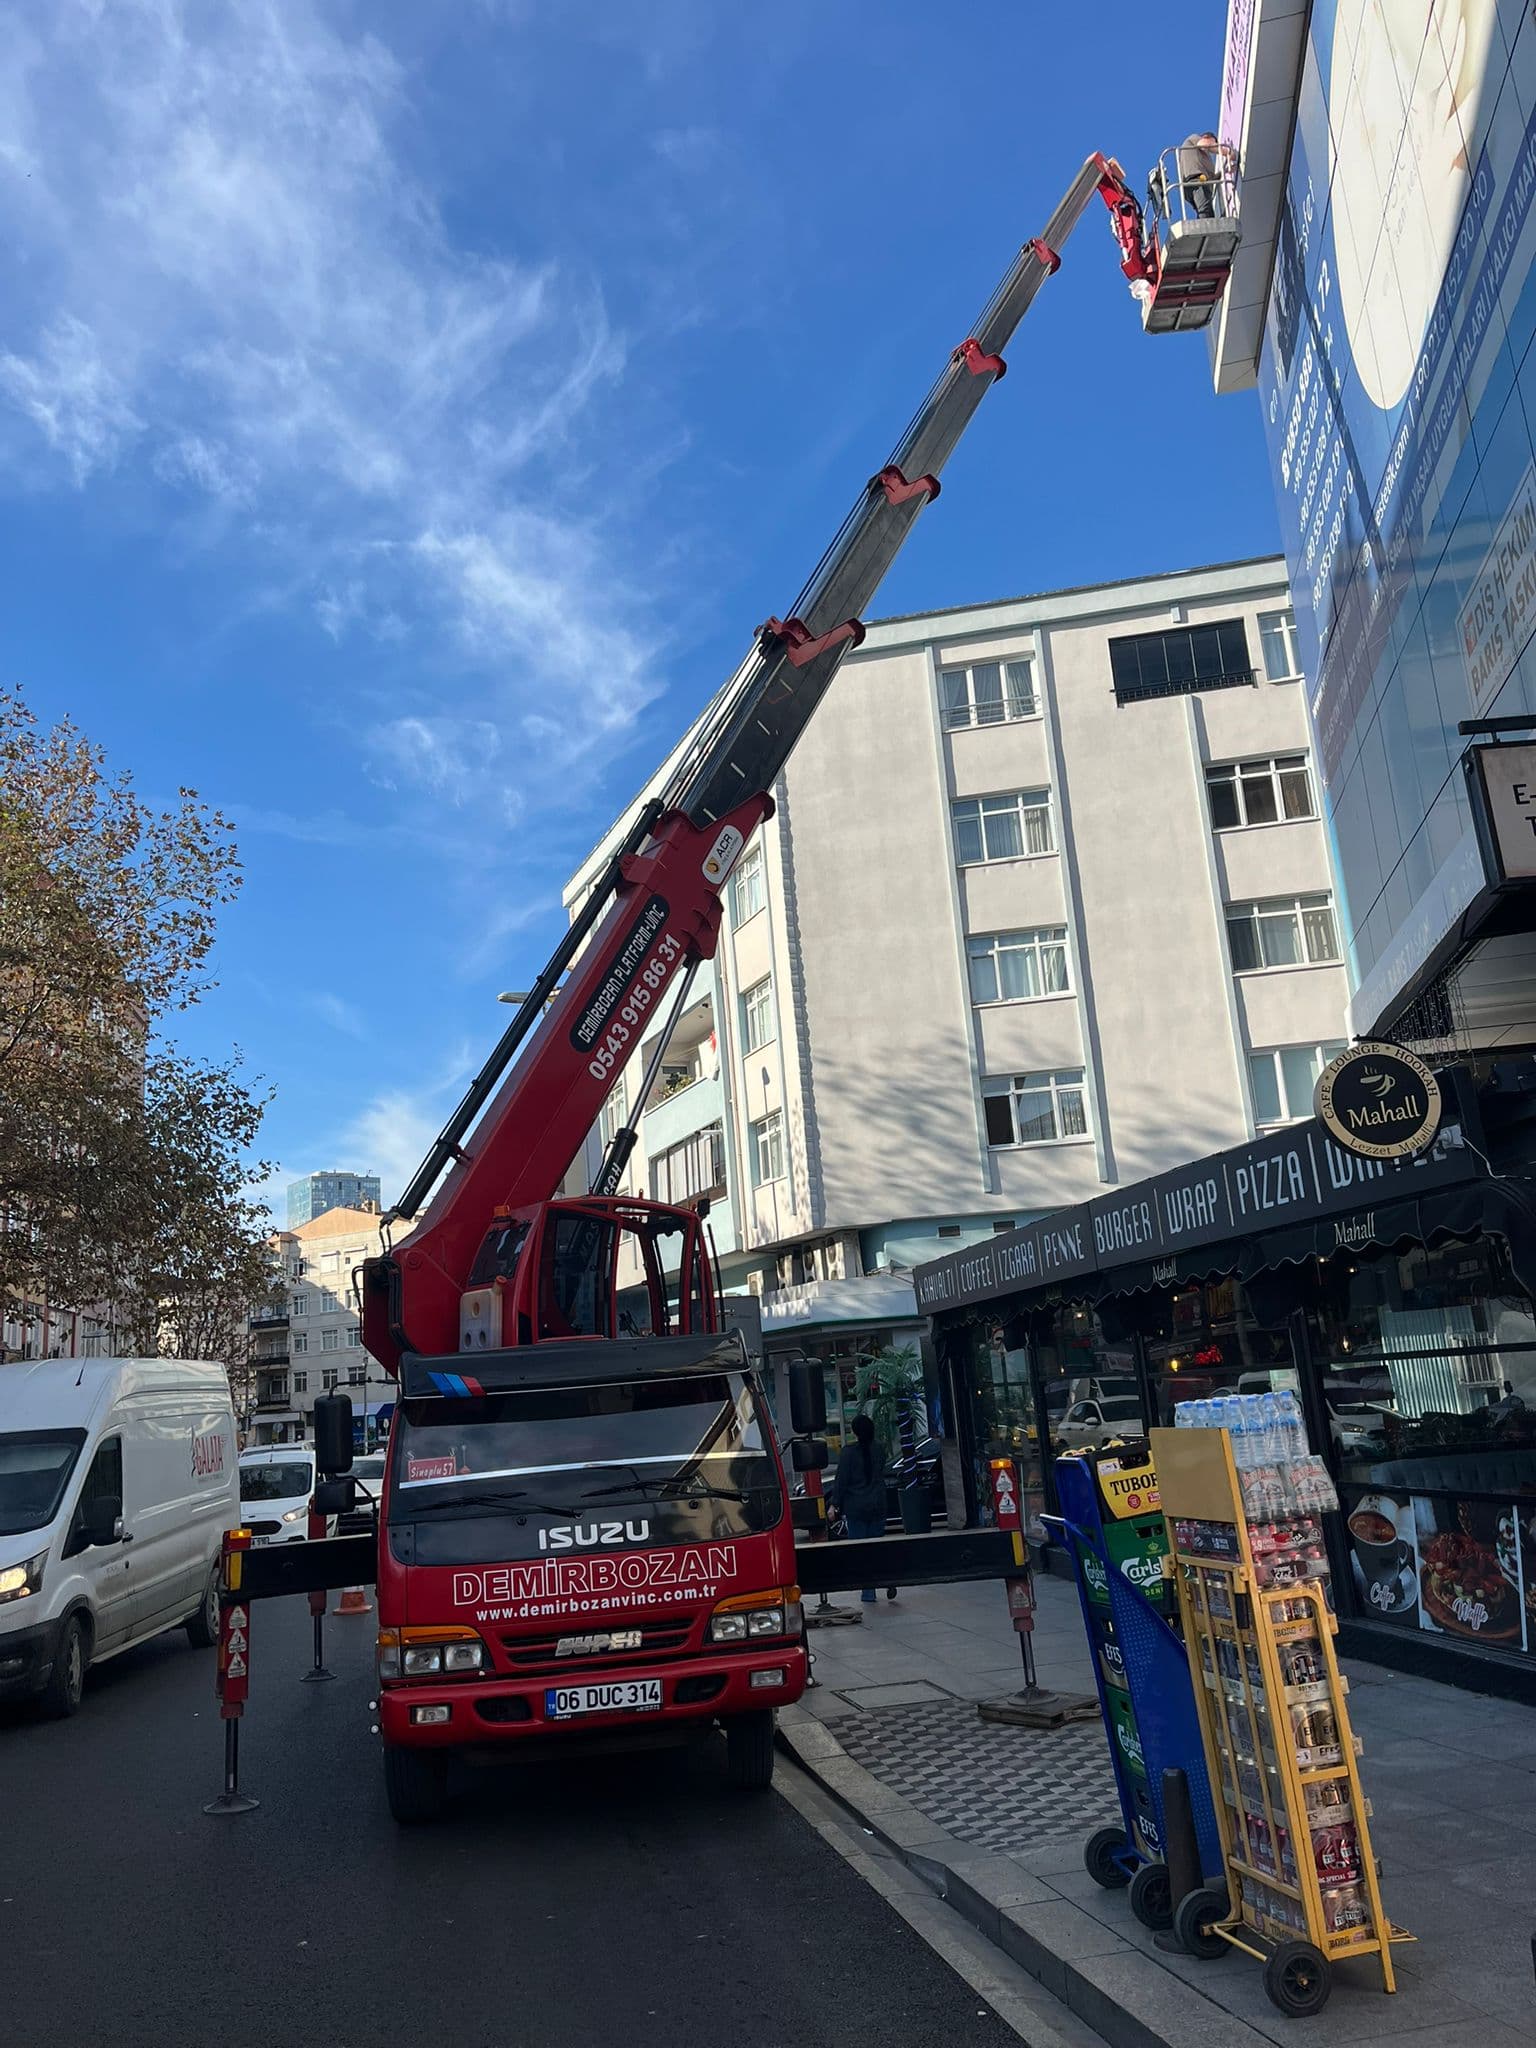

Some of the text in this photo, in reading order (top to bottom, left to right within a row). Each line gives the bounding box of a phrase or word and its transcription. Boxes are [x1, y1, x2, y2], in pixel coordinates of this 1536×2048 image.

[716, 833, 733, 858] ACR
[588, 932, 682, 1081] 0543 915 86 31
[1329, 1043, 1381, 1074] LOUNGE
[1393, 1048, 1439, 1097] HOOKAH
[1321, 1084, 1335, 1120] CAFE
[1346, 1094, 1422, 1129] Mahall
[1348, 1137, 1392, 1156] Lezzet
[960, 1255, 993, 1293] COFFEE
[1043, 1223, 1085, 1269] PENNE
[1094, 1201, 1153, 1254] BURGER
[1164, 1178, 1219, 1235] WRAP
[1235, 1153, 1306, 1215] PİZZA
[1333, 1211, 1377, 1246] Mahall
[538, 1519, 650, 1550] ISUZU
[453, 1545, 738, 1606] DEMİRBOZAN
[475, 1583, 718, 1622] www.demirbozanvinc.com.tr
[1370, 1581, 1396, 1612] Coffee
[557, 1682, 660, 1711] 06 DUC 314
